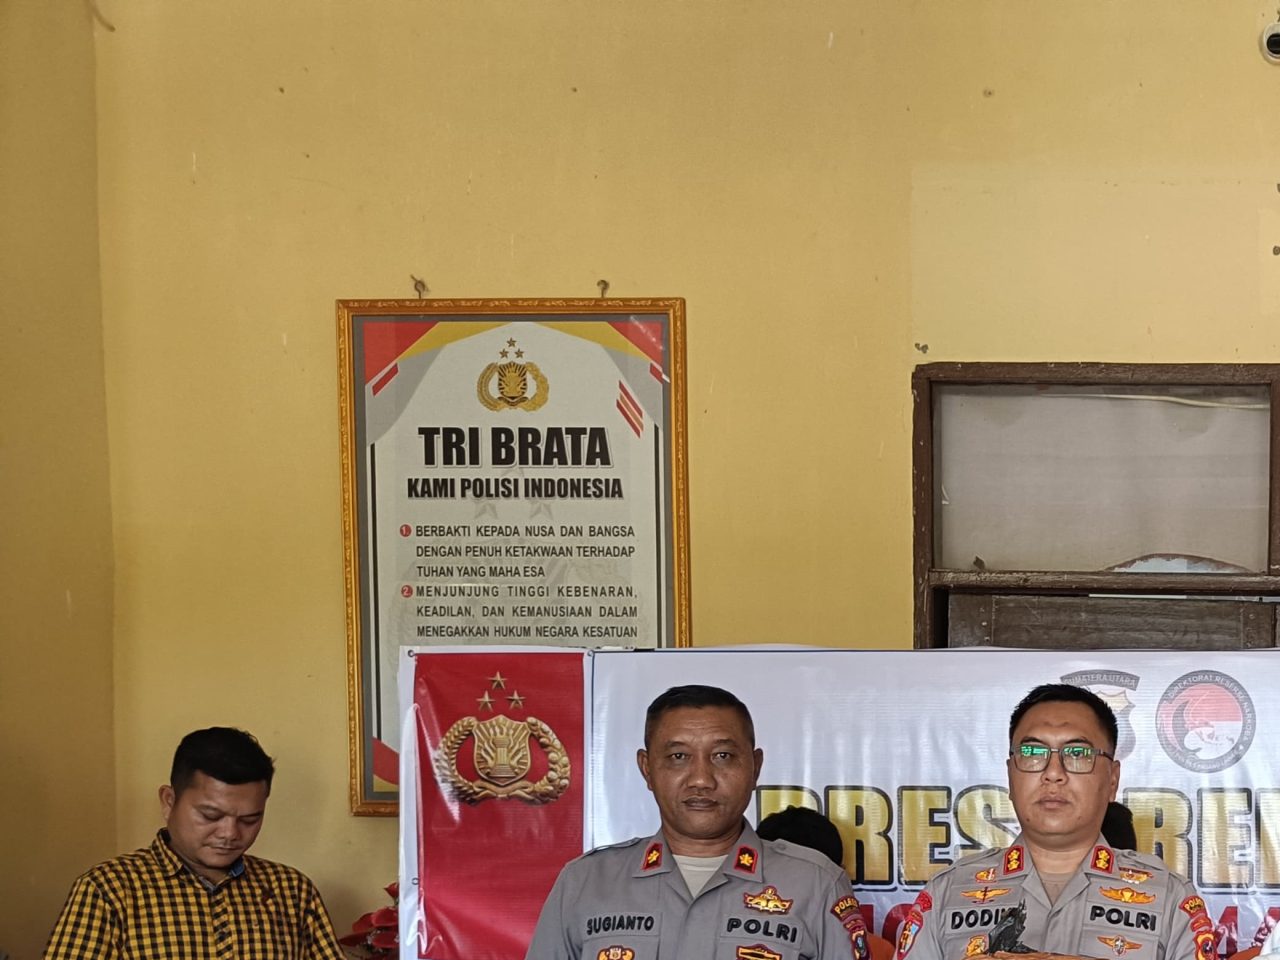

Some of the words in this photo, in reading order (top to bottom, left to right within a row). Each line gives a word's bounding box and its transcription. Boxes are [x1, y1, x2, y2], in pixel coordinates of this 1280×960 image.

[417, 427, 479, 467] TRI
[490, 427, 612, 467] BRATA
[407, 478, 456, 499] KAMI
[460, 478, 519, 499] POLISI
[524, 478, 623, 499] INDONESIA
[415, 525, 471, 538] BERBAKTI
[476, 525, 520, 538] KEPADA
[524, 525, 555, 538] NUSA
[560, 525, 583, 538] DAN
[588, 525, 635, 538] BANGSA
[416, 545, 463, 558] DENGAN
[465, 545, 503, 558] PENUH
[505, 545, 573, 558] KETAKWAAN
[576, 545, 635, 558] TERHADAP
[417, 565, 454, 578] TUHAN
[457, 565, 486, 578] YANG
[489, 565, 521, 578] MAHA
[523, 565, 546, 578] ESA
[416, 586, 499, 598] MENJUNJUNG
[507, 586, 550, 598] TINGGI
[416, 606, 475, 619] KEADILAN,
[482, 606, 505, 618] DAN
[511, 606, 592, 618] KEMANUSIAAN
[599, 606, 638, 618] DALAM
[417, 626, 490, 638] MENEGAKKAN
[494, 626, 532, 638] HUKUM
[535, 626, 579, 638] NEGARA
[583, 626, 638, 638] KESATUAN
[587, 915, 655, 936] SUGIANTO
[951, 908, 1006, 930] DODI
[1090, 905, 1157, 932] POLRI
[727, 917, 797, 944] POLRI
